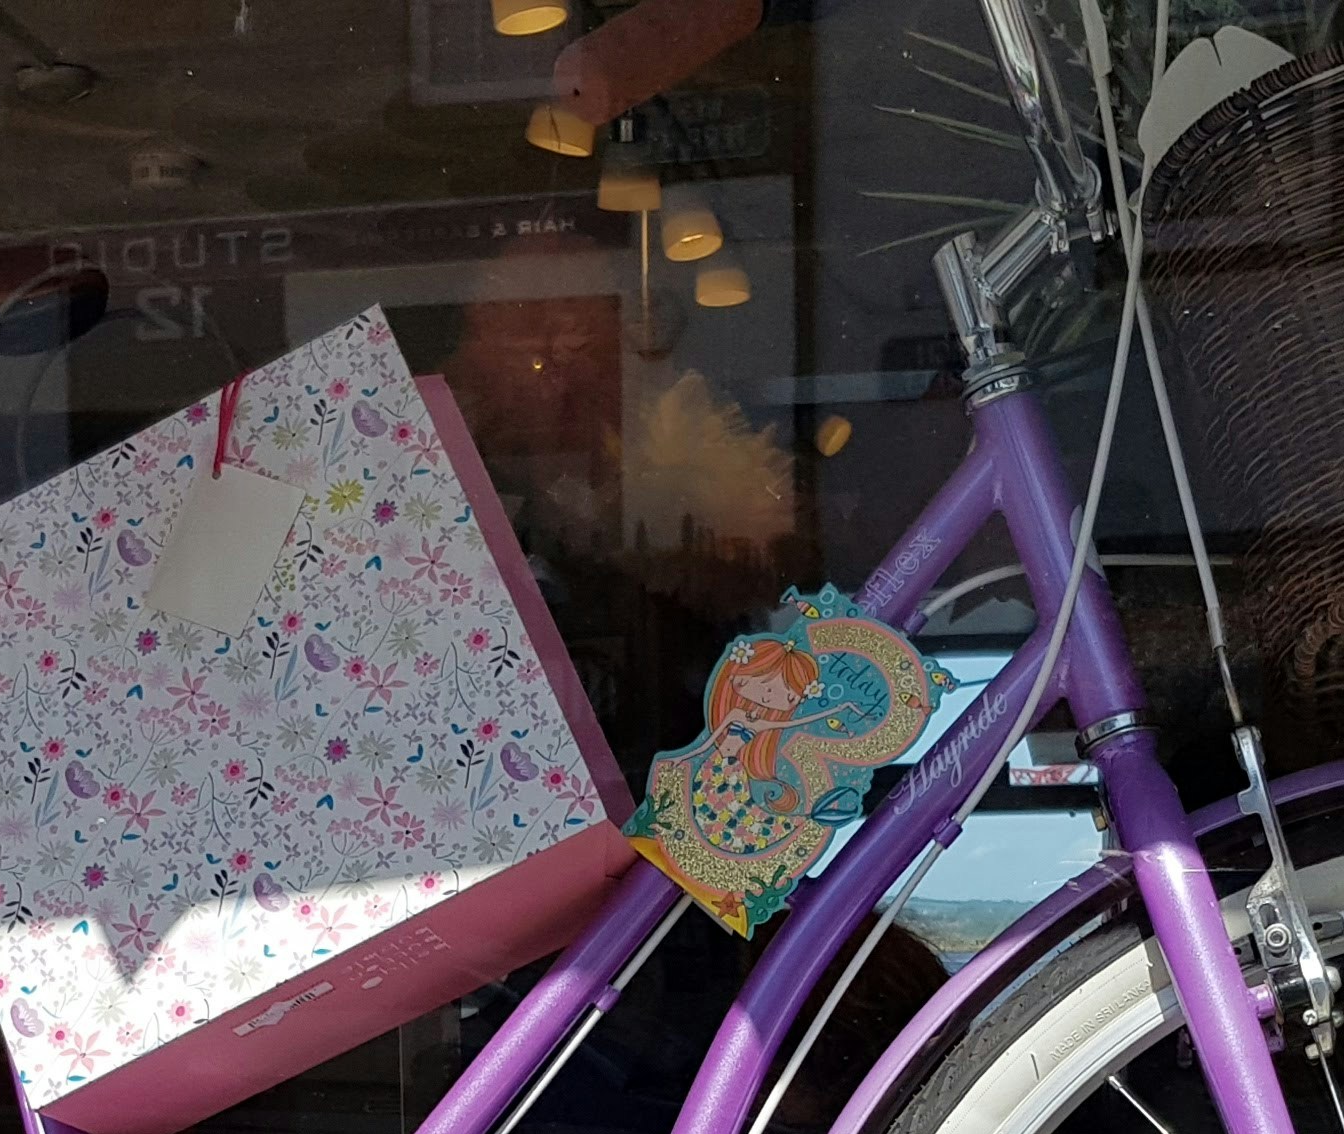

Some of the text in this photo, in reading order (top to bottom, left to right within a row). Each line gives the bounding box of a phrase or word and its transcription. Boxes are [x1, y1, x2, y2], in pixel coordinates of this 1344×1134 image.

[826, 652, 890, 722] today
[889, 690, 1009, 815] Hayride
[1049, 1029, 1082, 1061] MADE
[1080, 1019, 1097, 1034] IN
[1095, 1002, 1116, 1024] SRI
